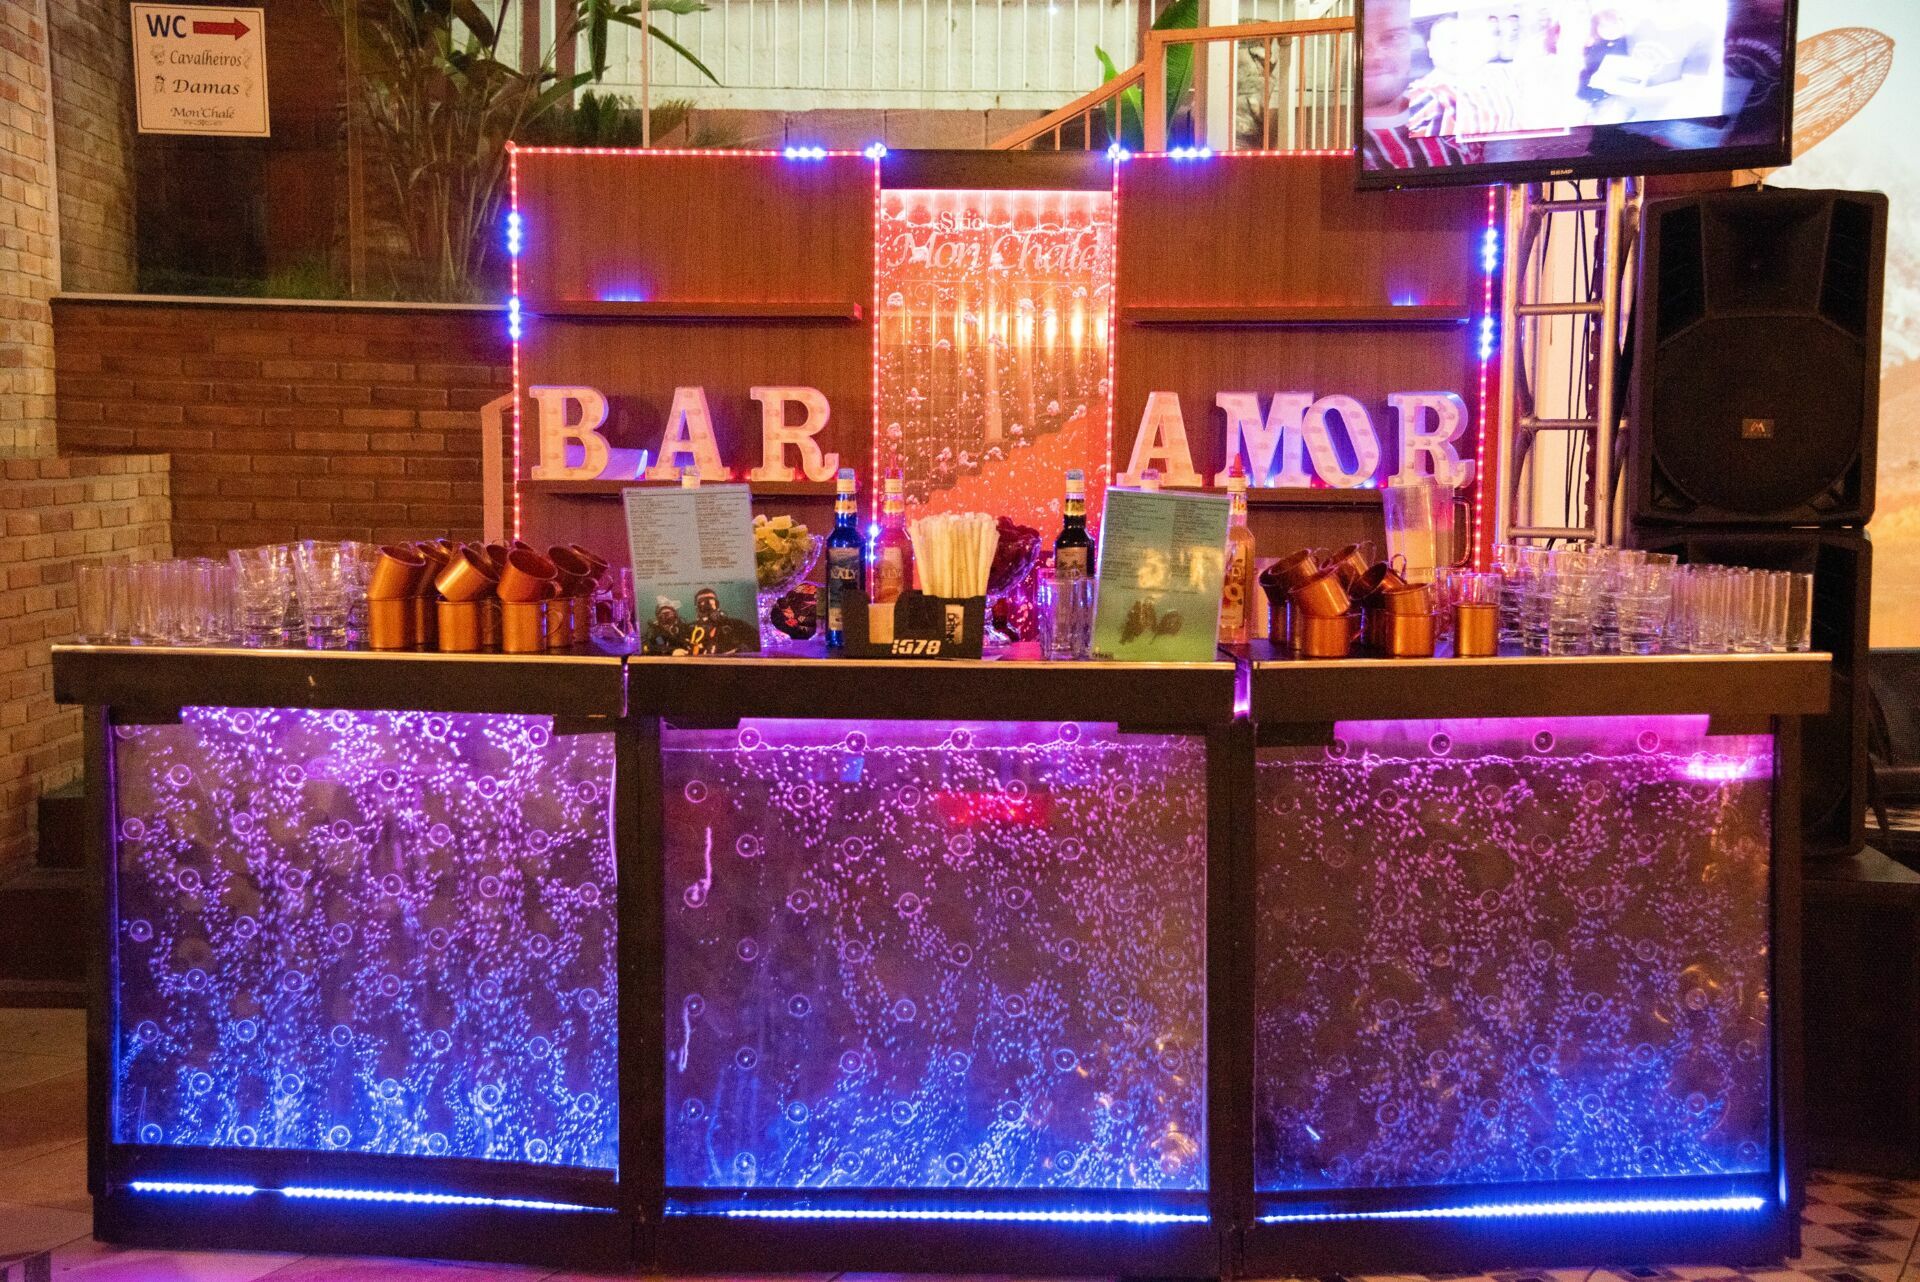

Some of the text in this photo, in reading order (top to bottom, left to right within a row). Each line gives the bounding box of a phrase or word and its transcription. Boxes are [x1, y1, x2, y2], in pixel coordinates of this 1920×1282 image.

[146, 13, 187, 39] WC
[169, 49, 243, 67] Cavalheiros
[172, 78, 240, 96] Damas
[529, 385, 840, 482] BAR
[1115, 390, 1475, 489] AMOR
